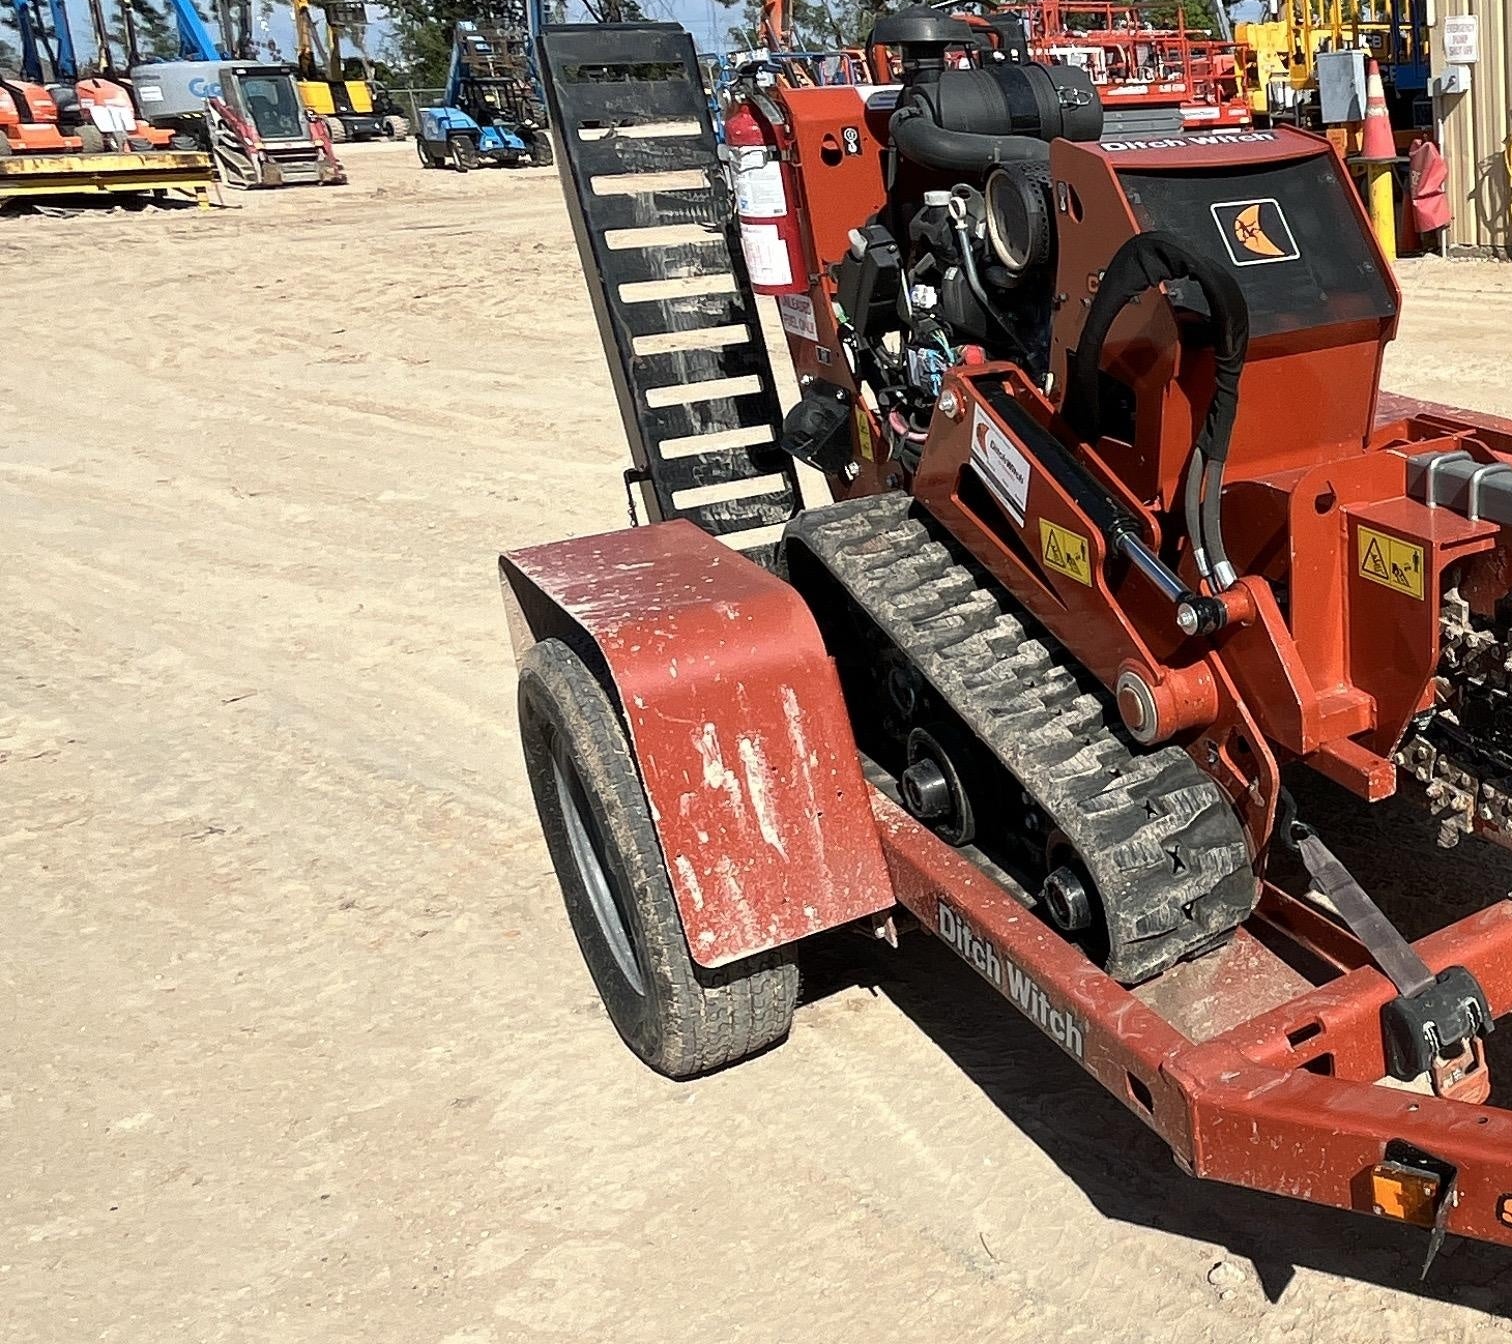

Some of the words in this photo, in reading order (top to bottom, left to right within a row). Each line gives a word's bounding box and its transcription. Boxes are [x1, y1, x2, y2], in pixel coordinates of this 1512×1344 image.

[1100, 138, 1187, 153] Ditch
[1188, 132, 1275, 146] Witch
[938, 902, 1001, 985] Ditch
[1006, 961, 1083, 1058] Witch
